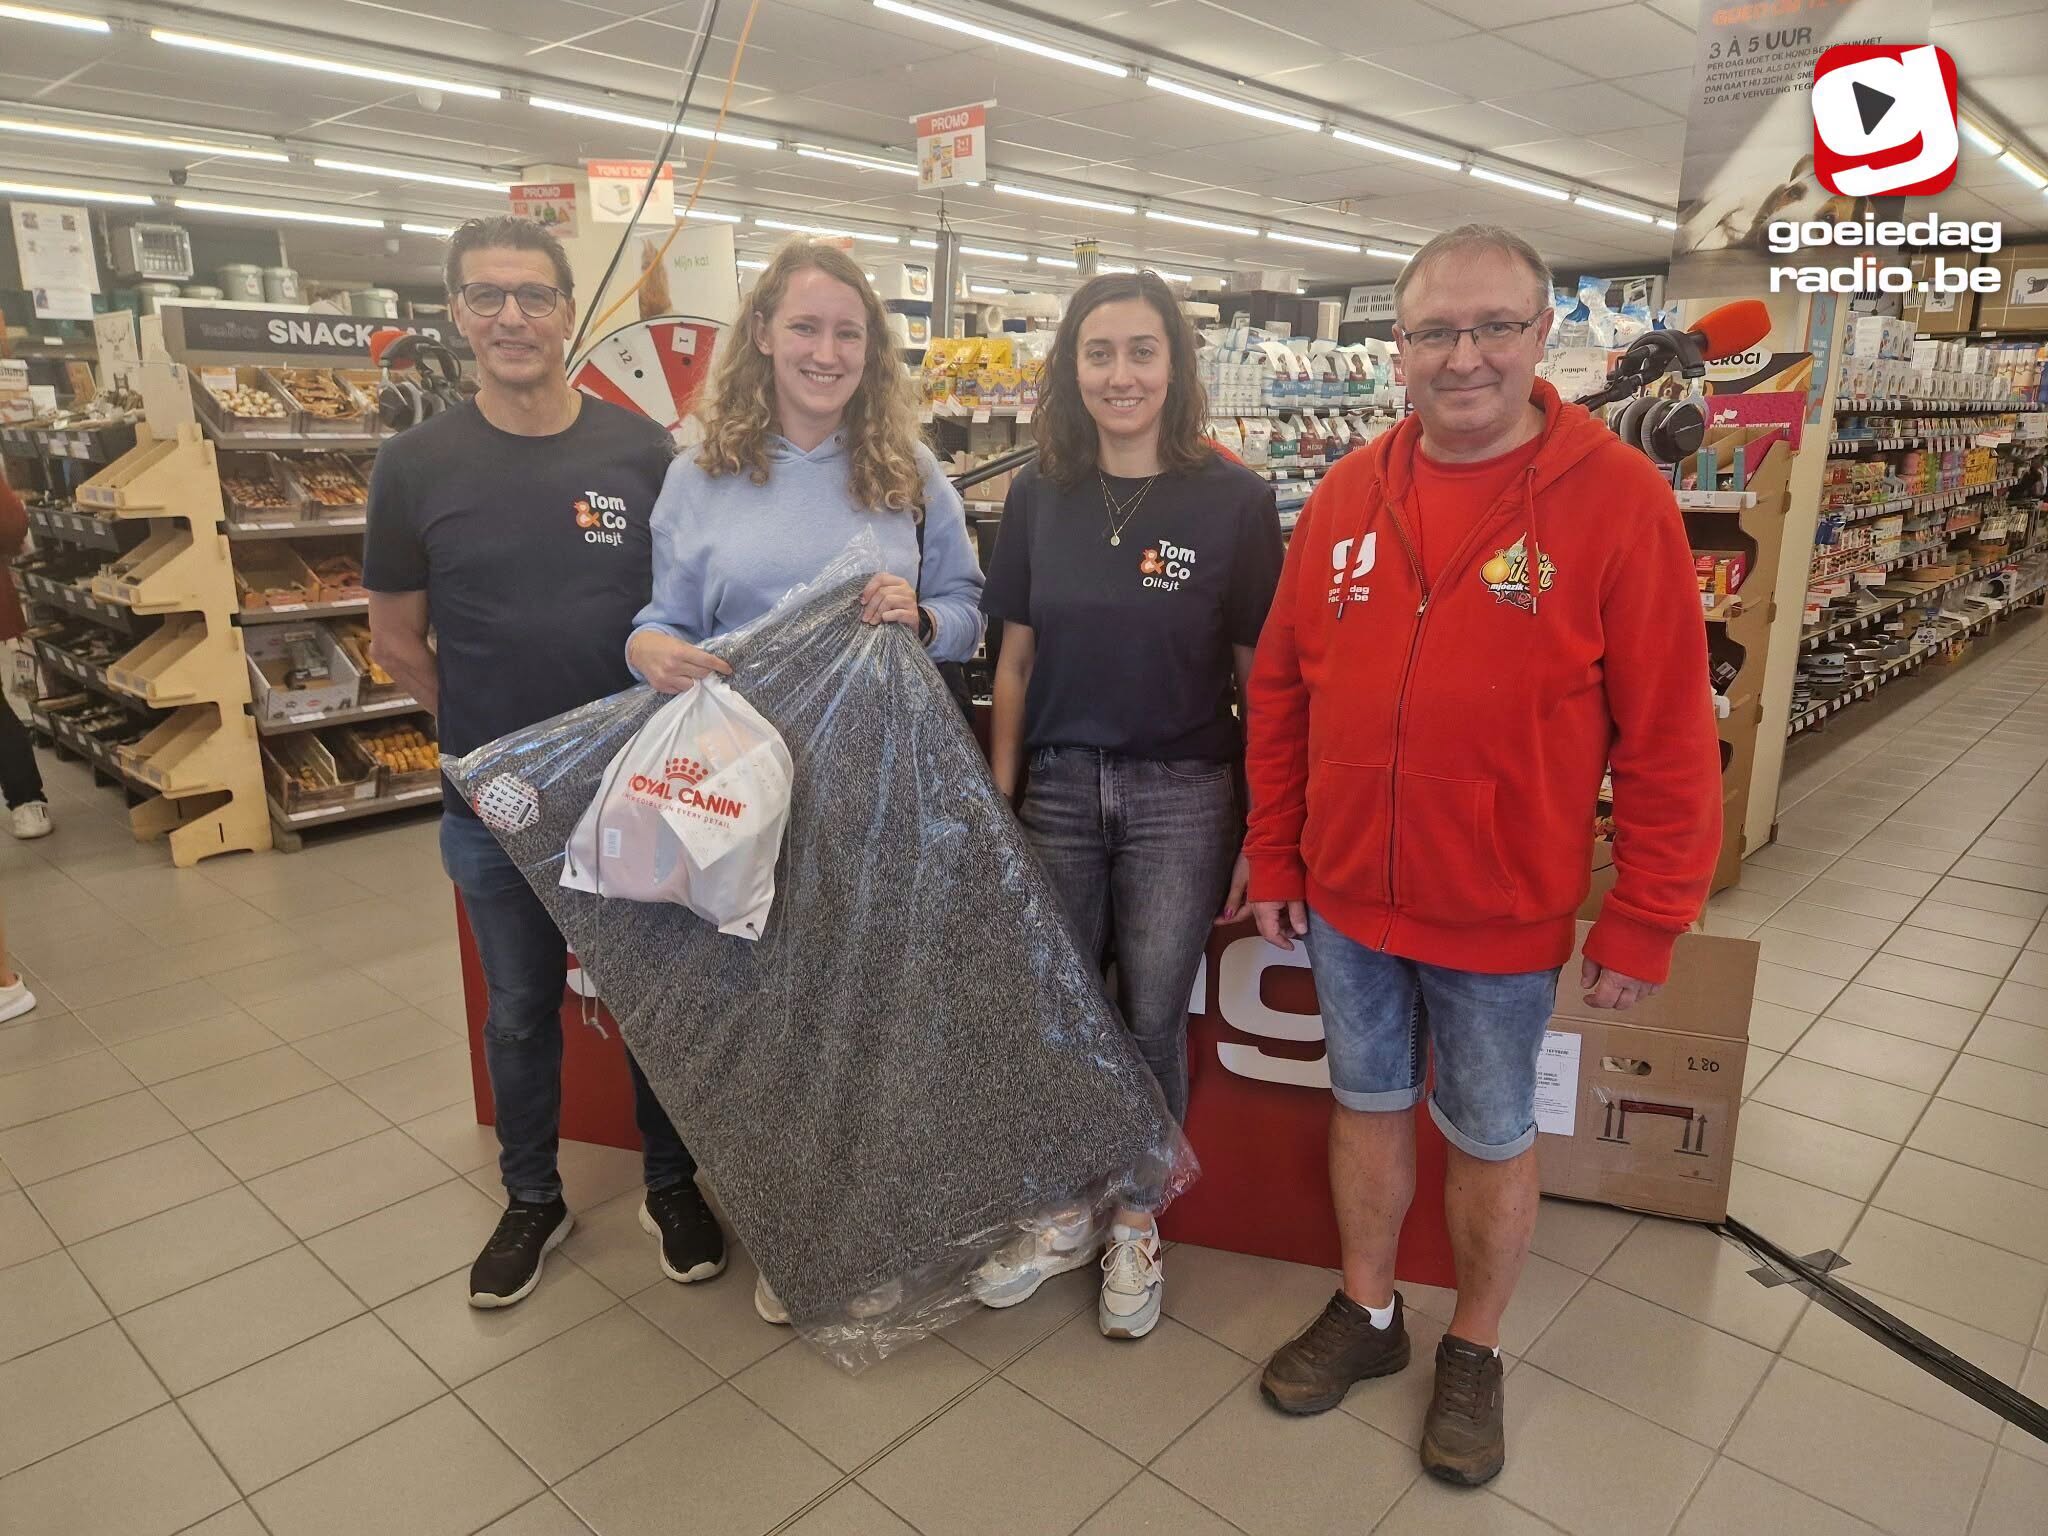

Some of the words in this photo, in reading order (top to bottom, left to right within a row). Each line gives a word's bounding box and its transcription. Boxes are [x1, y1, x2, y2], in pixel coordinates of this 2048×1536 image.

[1709, 42, 1721, 59] 3
[1726, 35, 1742, 58] À
[1748, 36, 1759, 53] 5
[1765, 26, 1812, 50] UUR
[1707, 62, 1724, 71] PER
[1725, 59, 1744, 69] DAG
[1746, 55, 1770, 65] MOET
[1772, 51, 1784, 61] DE
[1785, 48, 1811, 59] HOND
[1766, 64, 1781, 73] ALS
[1784, 61, 1801, 71] DAT
[1704, 84, 1722, 94] DAN
[1724, 80, 1747, 90] GAAT
[1762, 75, 1782, 85] ZICH
[1784, 73, 1794, 81] AL
[1703, 96, 1715, 105] ZO
[1717, 94, 1729, 103] GA
[1731, 92, 1741, 101] JE
[1743, 85, 1791, 99] VERVELING
[931, 111, 969, 133] PROMO
[522, 187, 560, 198] PROMO
[268, 319, 375, 348] SNACK
[618, 349, 633, 365] 12
[584, 490, 627, 512] Tom
[602, 511, 627, 530] Co
[584, 530, 623, 547] Oilsjt
[1158, 539, 1196, 564] Tom
[1165, 561, 1191, 580] Co
[1142, 576, 1180, 592] Oilsjt
[678, 787, 742, 819] CANIN
